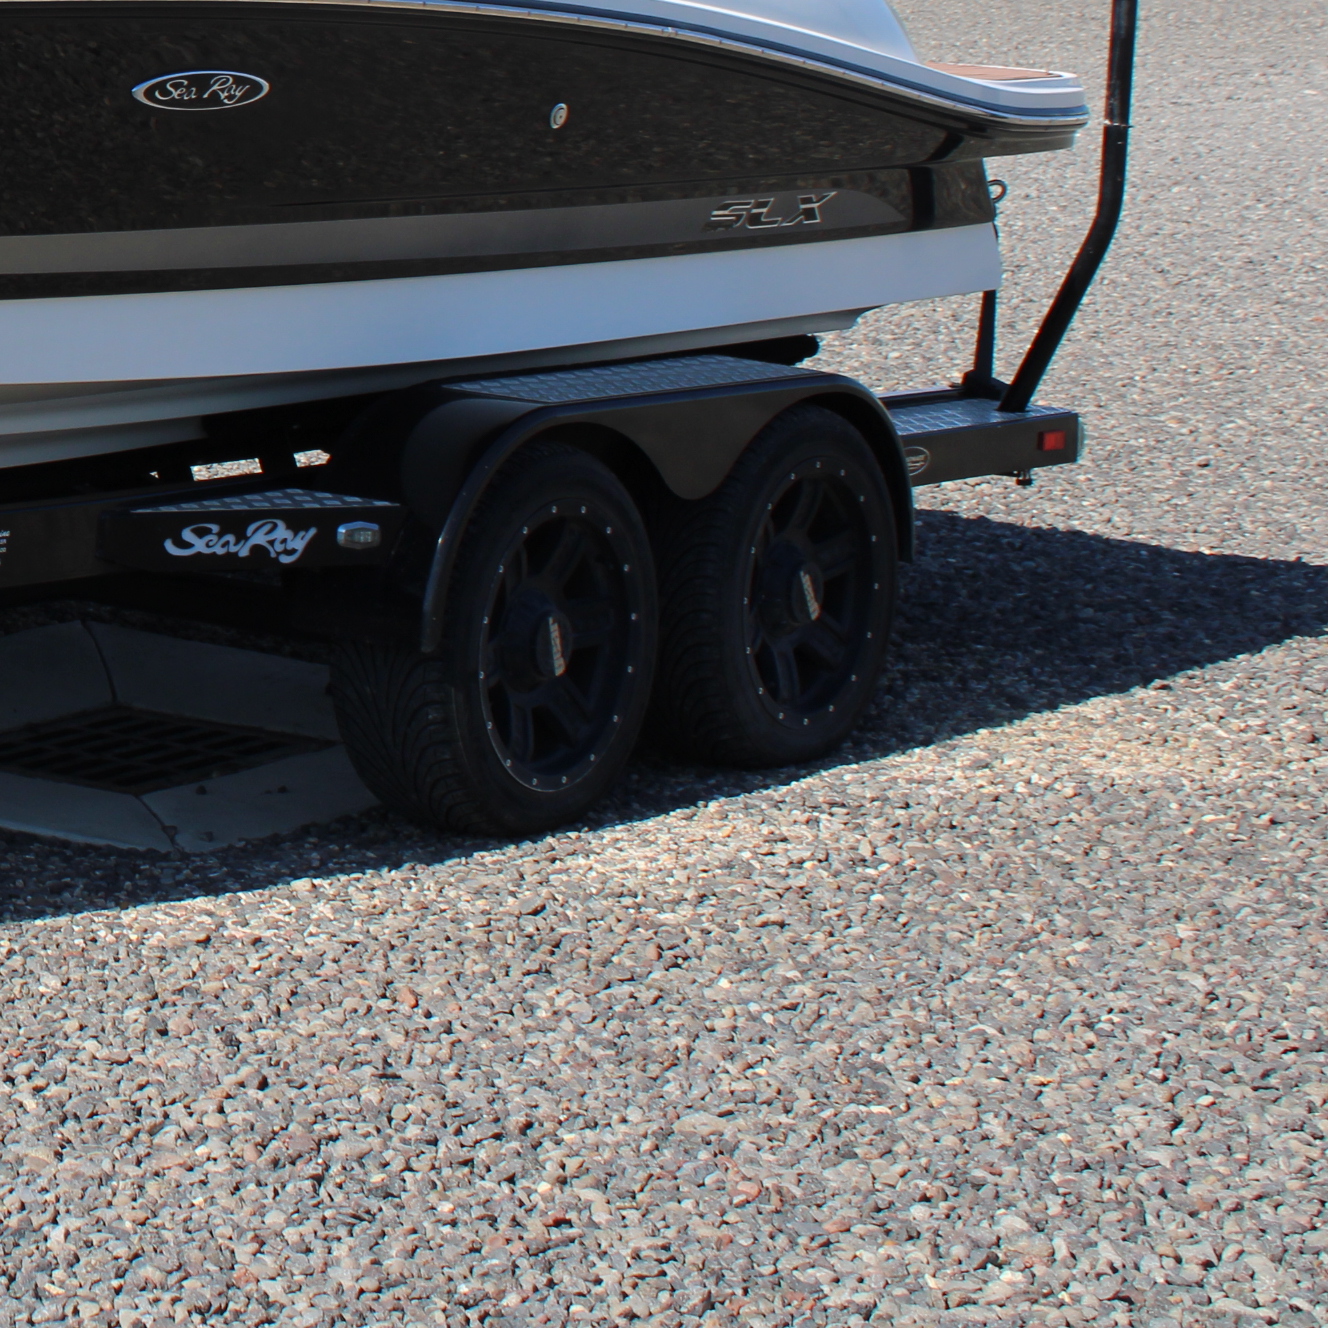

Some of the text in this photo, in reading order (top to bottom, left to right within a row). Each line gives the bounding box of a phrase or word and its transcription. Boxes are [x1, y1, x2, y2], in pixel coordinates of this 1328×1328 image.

[155, 75, 251, 104] Sea Ray
[702, 191, 838, 230] SLX
